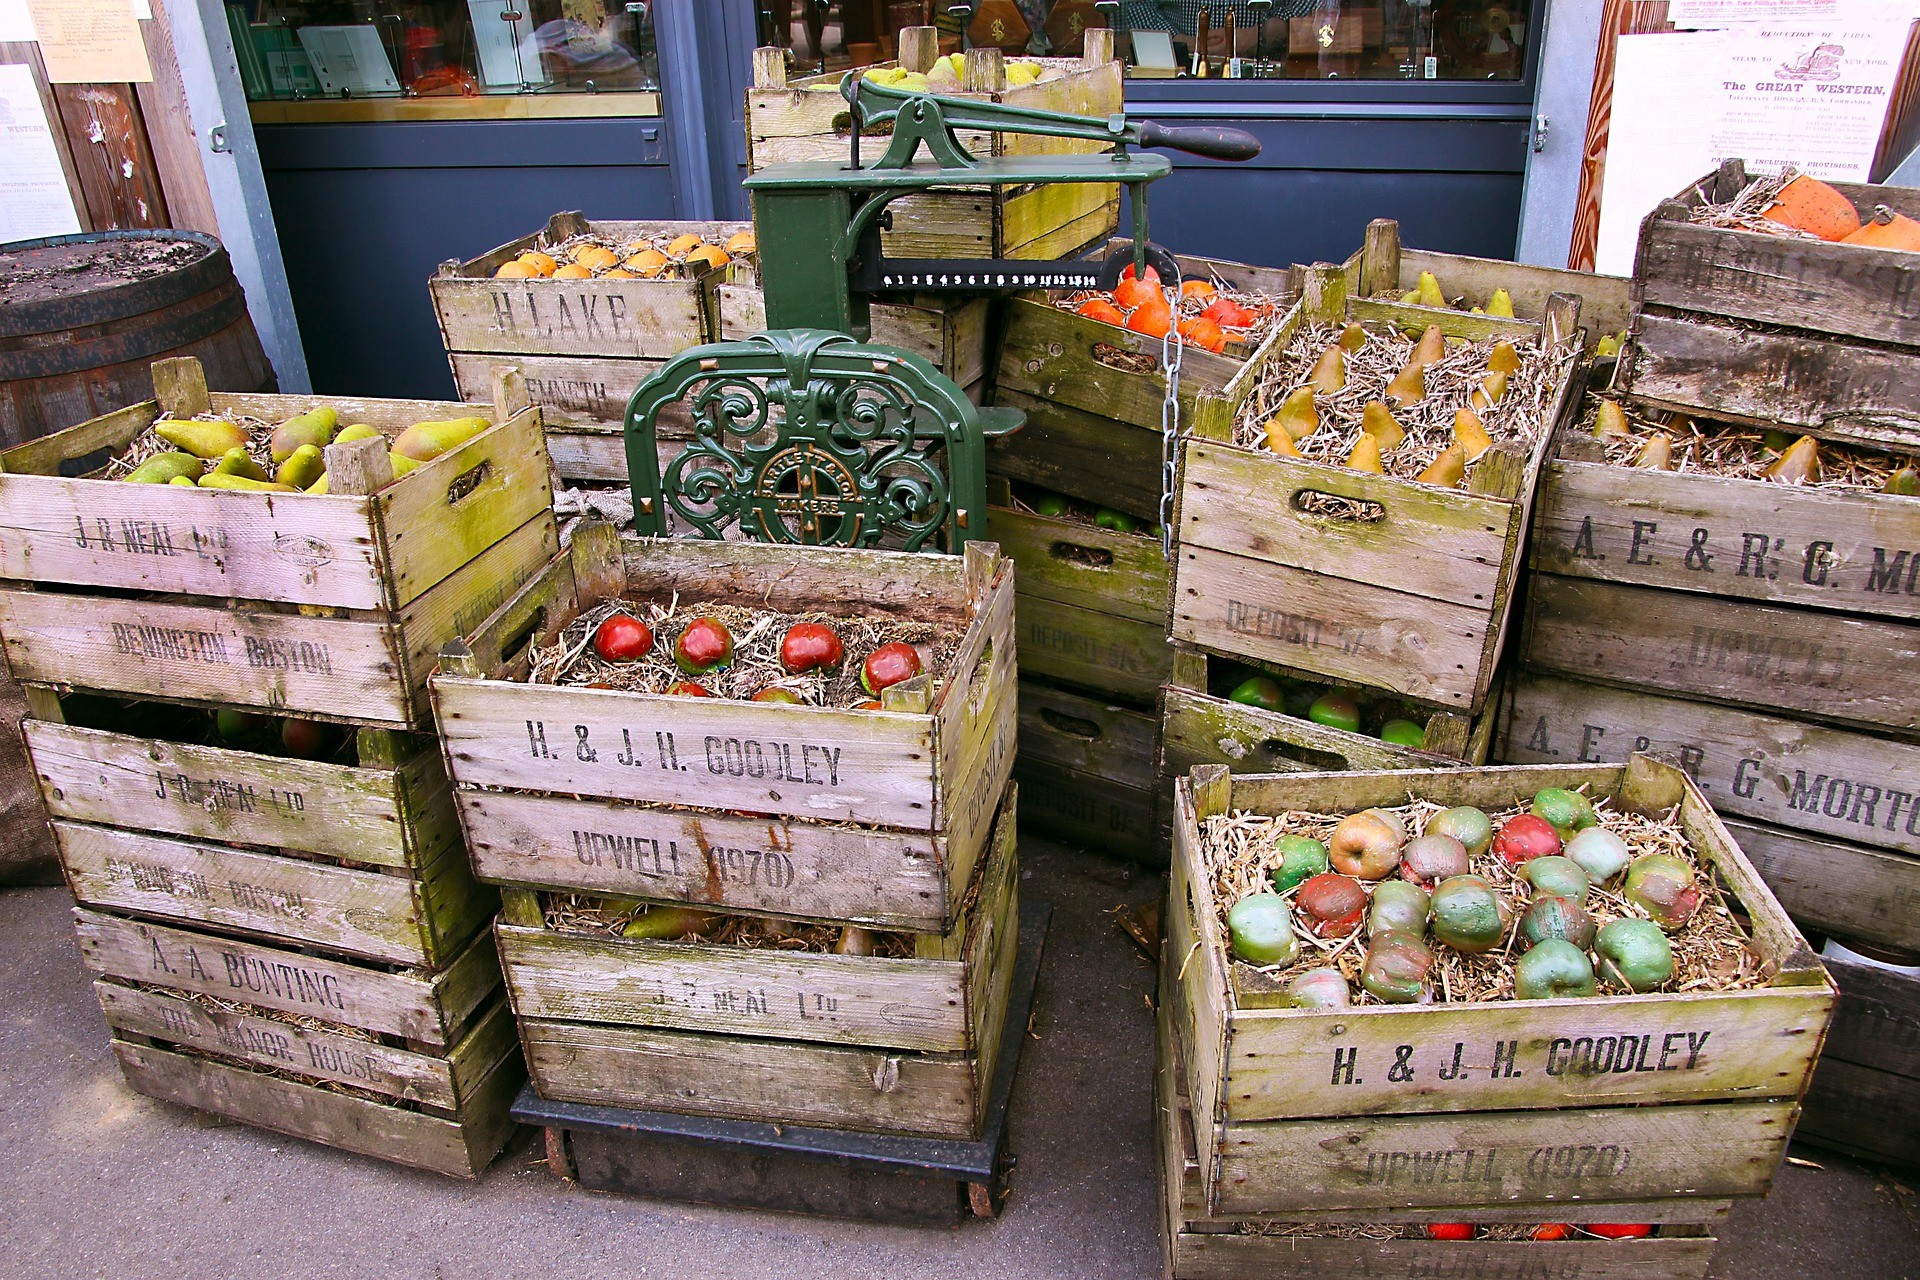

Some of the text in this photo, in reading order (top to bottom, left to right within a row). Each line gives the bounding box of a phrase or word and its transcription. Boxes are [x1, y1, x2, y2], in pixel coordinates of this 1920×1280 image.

[1760, 31, 1814, 39] REDUCTION
[1723, 82, 1886, 96] The GREAT WESTERN,
[1755, 159, 1801, 167] INCLUDING
[897, 275, 904, 286] 1
[911, 275, 919, 286] 2
[939, 275, 948, 286] 4
[954, 275, 961, 286] 5
[968, 275, 976, 286] 6
[1011, 275, 1019, 286] 9
[1023, 275, 1036, 286] 10
[1053, 275, 1066, 286] 12
[1083, 275, 1096, 286] 14
[761, 452, 855, 503] BARTLETT & SON
[777, 498, 839, 514] MAKERS
[121, 518, 182, 557] NEAL
[1573, 515, 1606, 561] A.
[1684, 527, 1715, 573] &
[1802, 541, 1840, 589] G.
[1227, 598, 1323, 650] DEPOSIT
[244, 635, 334, 676] BOSTON
[526, 719, 842, 787] H. & J. H. GOODLEY
[1525, 715, 1559, 756] A.
[1732, 758, 1764, 802] G.
[572, 830, 796, 890] UPWELL (1970)
[152, 937, 345, 1010] A. A. BUNTING
[158, 1005, 202, 1038] THE
[216, 1026, 295, 1062] MANOR
[306, 1041, 383, 1085] HOUSE
[1331, 1030, 1712, 1086] H. & J. H. GOODLEY
[1366, 1143, 1632, 1187] UPWELL (1970)
